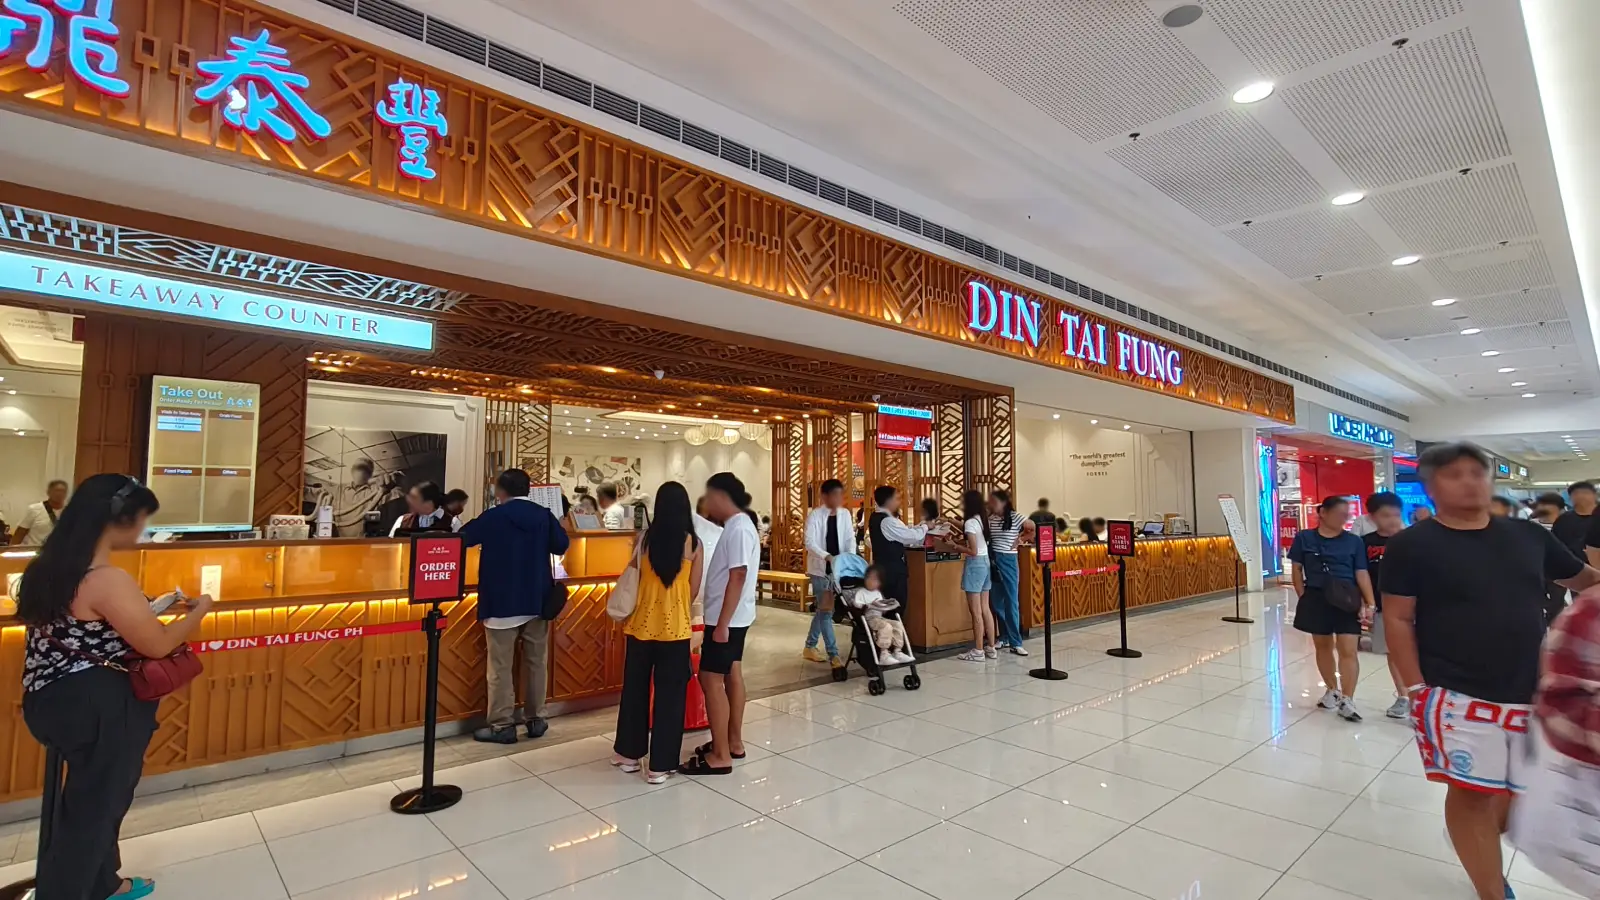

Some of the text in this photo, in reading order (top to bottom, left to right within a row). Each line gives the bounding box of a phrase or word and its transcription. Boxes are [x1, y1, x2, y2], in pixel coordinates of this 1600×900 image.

[31, 265, 379, 335] TAKEAWAY COUNTER
[967, 280, 1183, 386] DIN TAI FUNG
[158, 385, 223, 400] Take Out
[1102, 452, 1126, 460] greatest
[419, 562, 457, 572] ORDER
[424, 571, 452, 581] HERE
[226, 637, 259, 650] DIN
[265, 634, 290, 646] TAI
[294, 629, 340, 643] FUNG
[344, 626, 363, 637] PH
